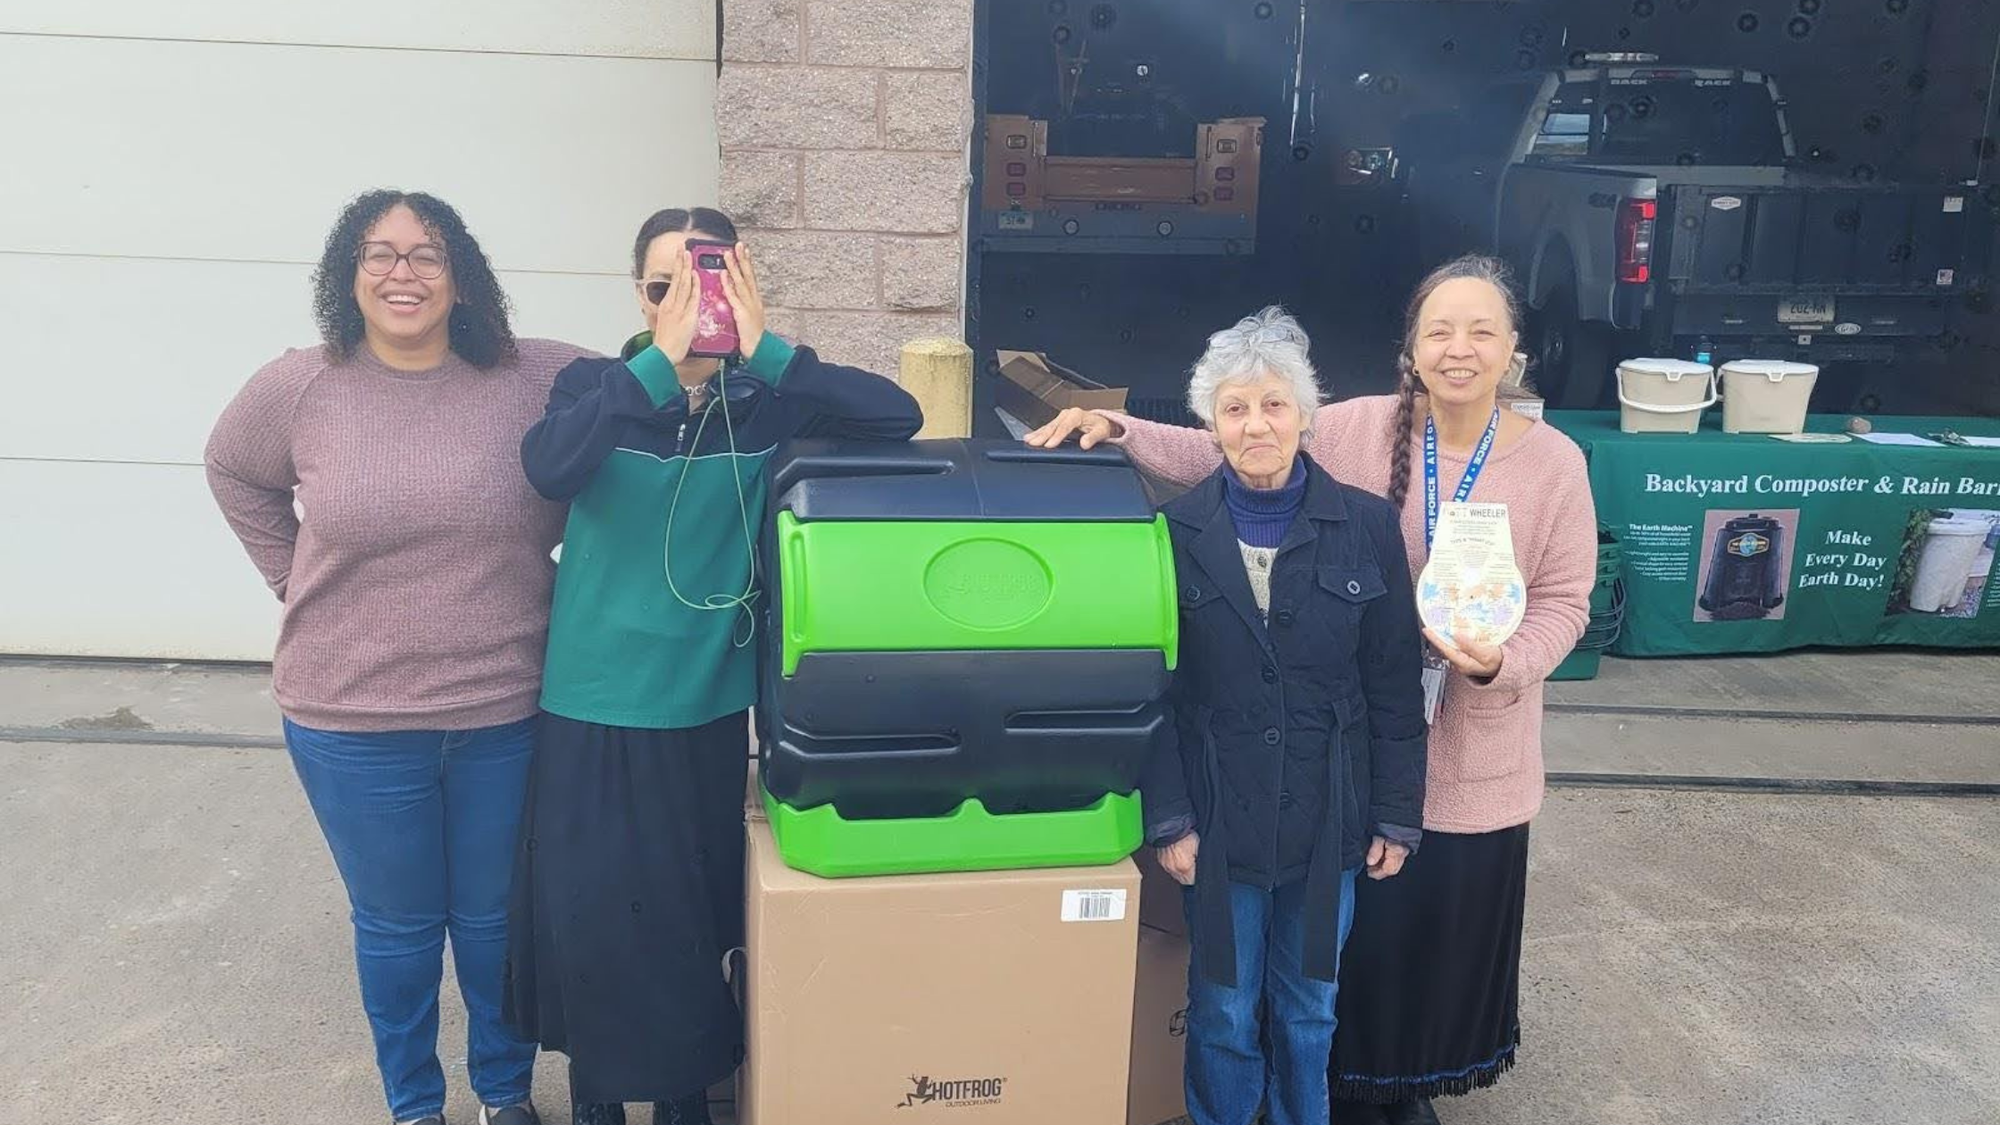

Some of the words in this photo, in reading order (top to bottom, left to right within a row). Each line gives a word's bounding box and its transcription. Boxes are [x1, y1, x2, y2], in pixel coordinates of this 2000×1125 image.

[1644, 473, 1748, 498] Backyard
[1754, 475, 1870, 497] Composter
[1873, 475, 1895, 494] &
[1900, 476, 1951, 495] Rain
[1470, 508, 1506, 518] WHEELER
[1825, 530, 1872, 546] Make
[1805, 552, 1849, 568] Every
[1852, 552, 1887, 571] Day
[1799, 571, 1839, 588] Earth
[1844, 572, 1885, 591] Day!
[945, 1100, 979, 1108] OUTDOOR
[980, 1098, 1001, 1106] LIVING
